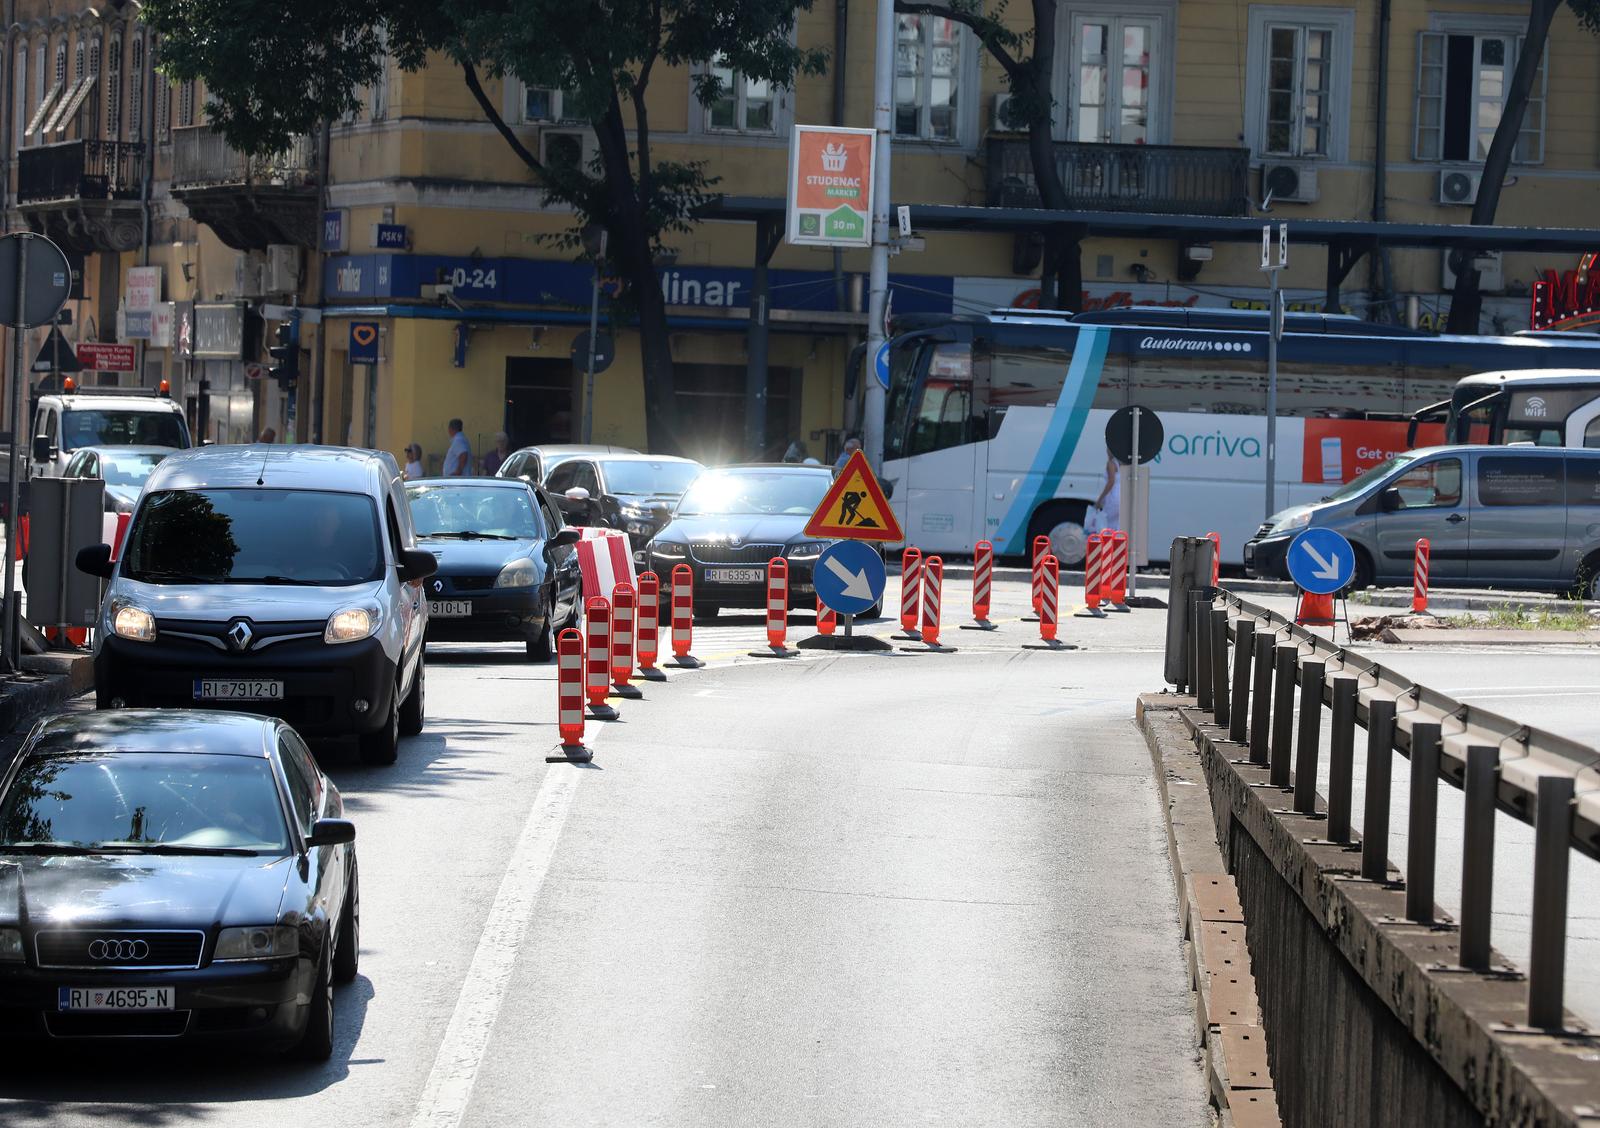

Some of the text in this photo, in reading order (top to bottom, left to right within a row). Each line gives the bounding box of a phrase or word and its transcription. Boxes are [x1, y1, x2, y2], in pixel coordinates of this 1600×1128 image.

[806, 175, 861, 187] STUDENAC
[826, 188, 858, 197] MARKET
[832, 220, 856, 230] 30 m
[381, 231, 397, 243] PSK
[661, 271, 742, 306] linar
[1168, 430, 1261, 458] arriva
[1356, 446, 1383, 460] Get
[711, 570, 721, 580] RI
[203, 682, 218, 697] RI
[71, 989, 168, 1008] RI 4695-N
